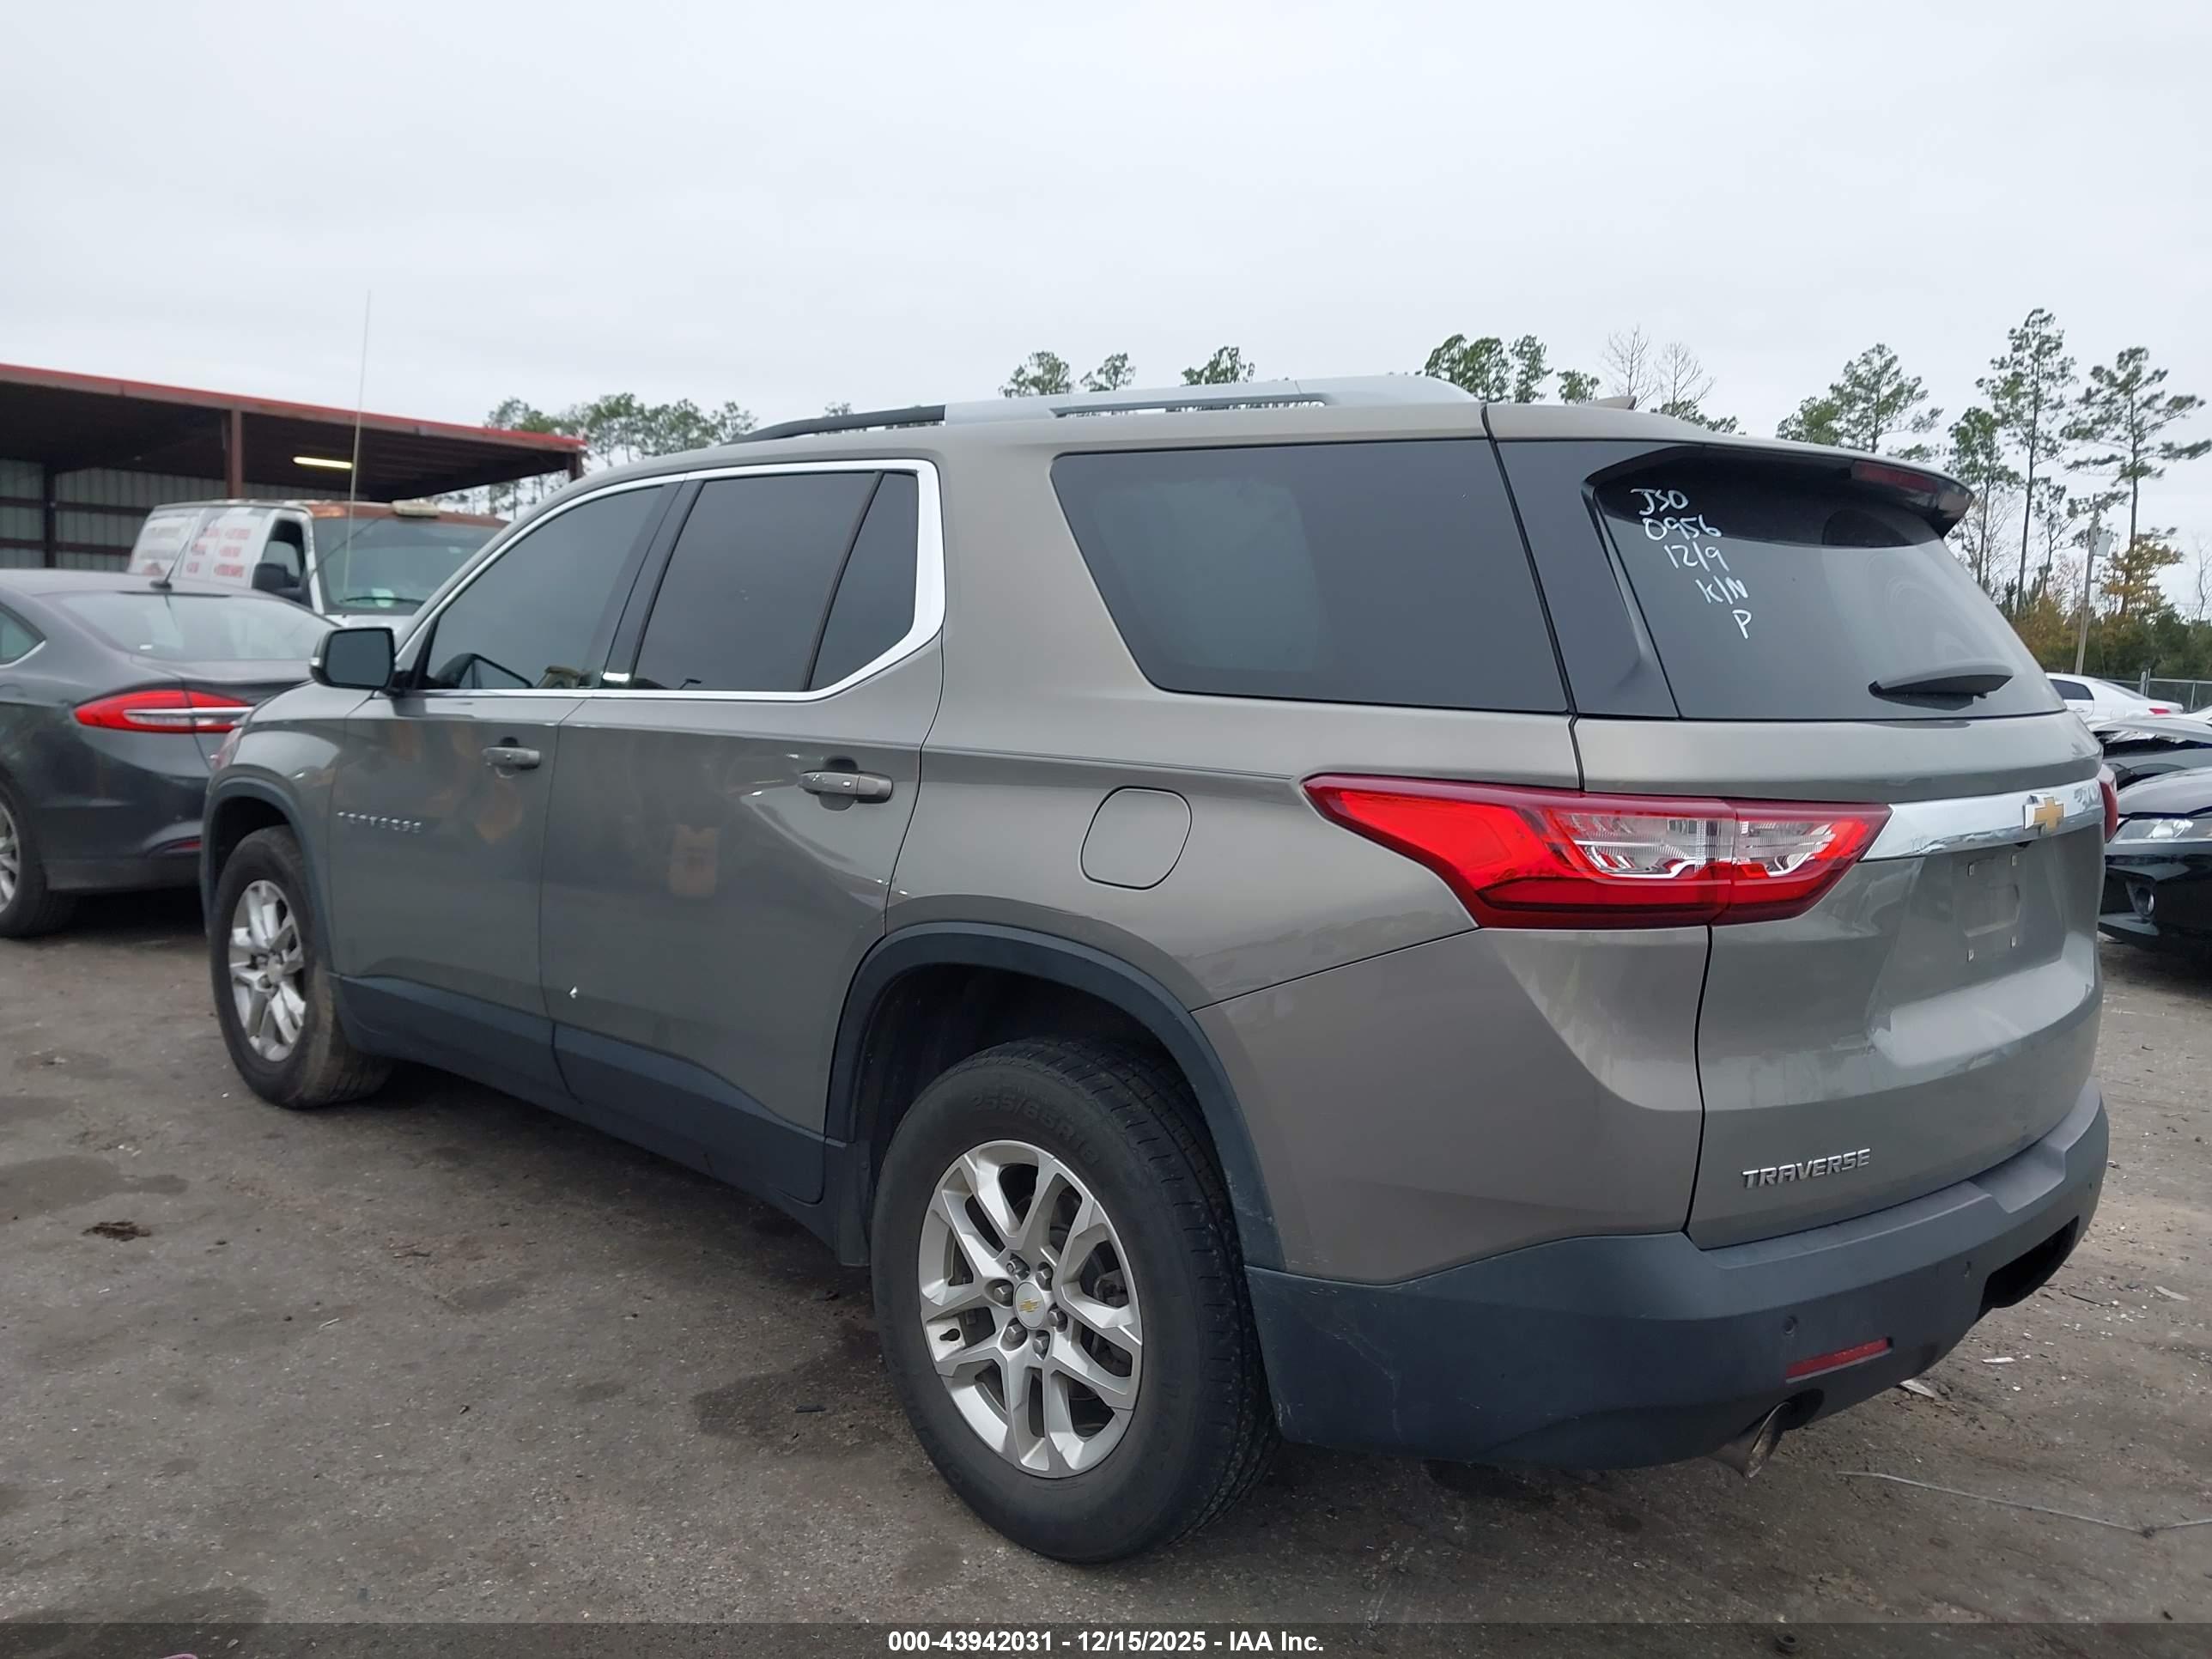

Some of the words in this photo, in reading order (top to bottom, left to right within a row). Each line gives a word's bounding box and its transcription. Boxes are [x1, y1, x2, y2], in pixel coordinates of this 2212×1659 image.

[1642, 514, 1723, 541] 0956
[1663, 541, 1729, 572] 12/9
[1732, 609, 1753, 639] P
[1741, 1148, 1870, 1189] TRAVERSE
